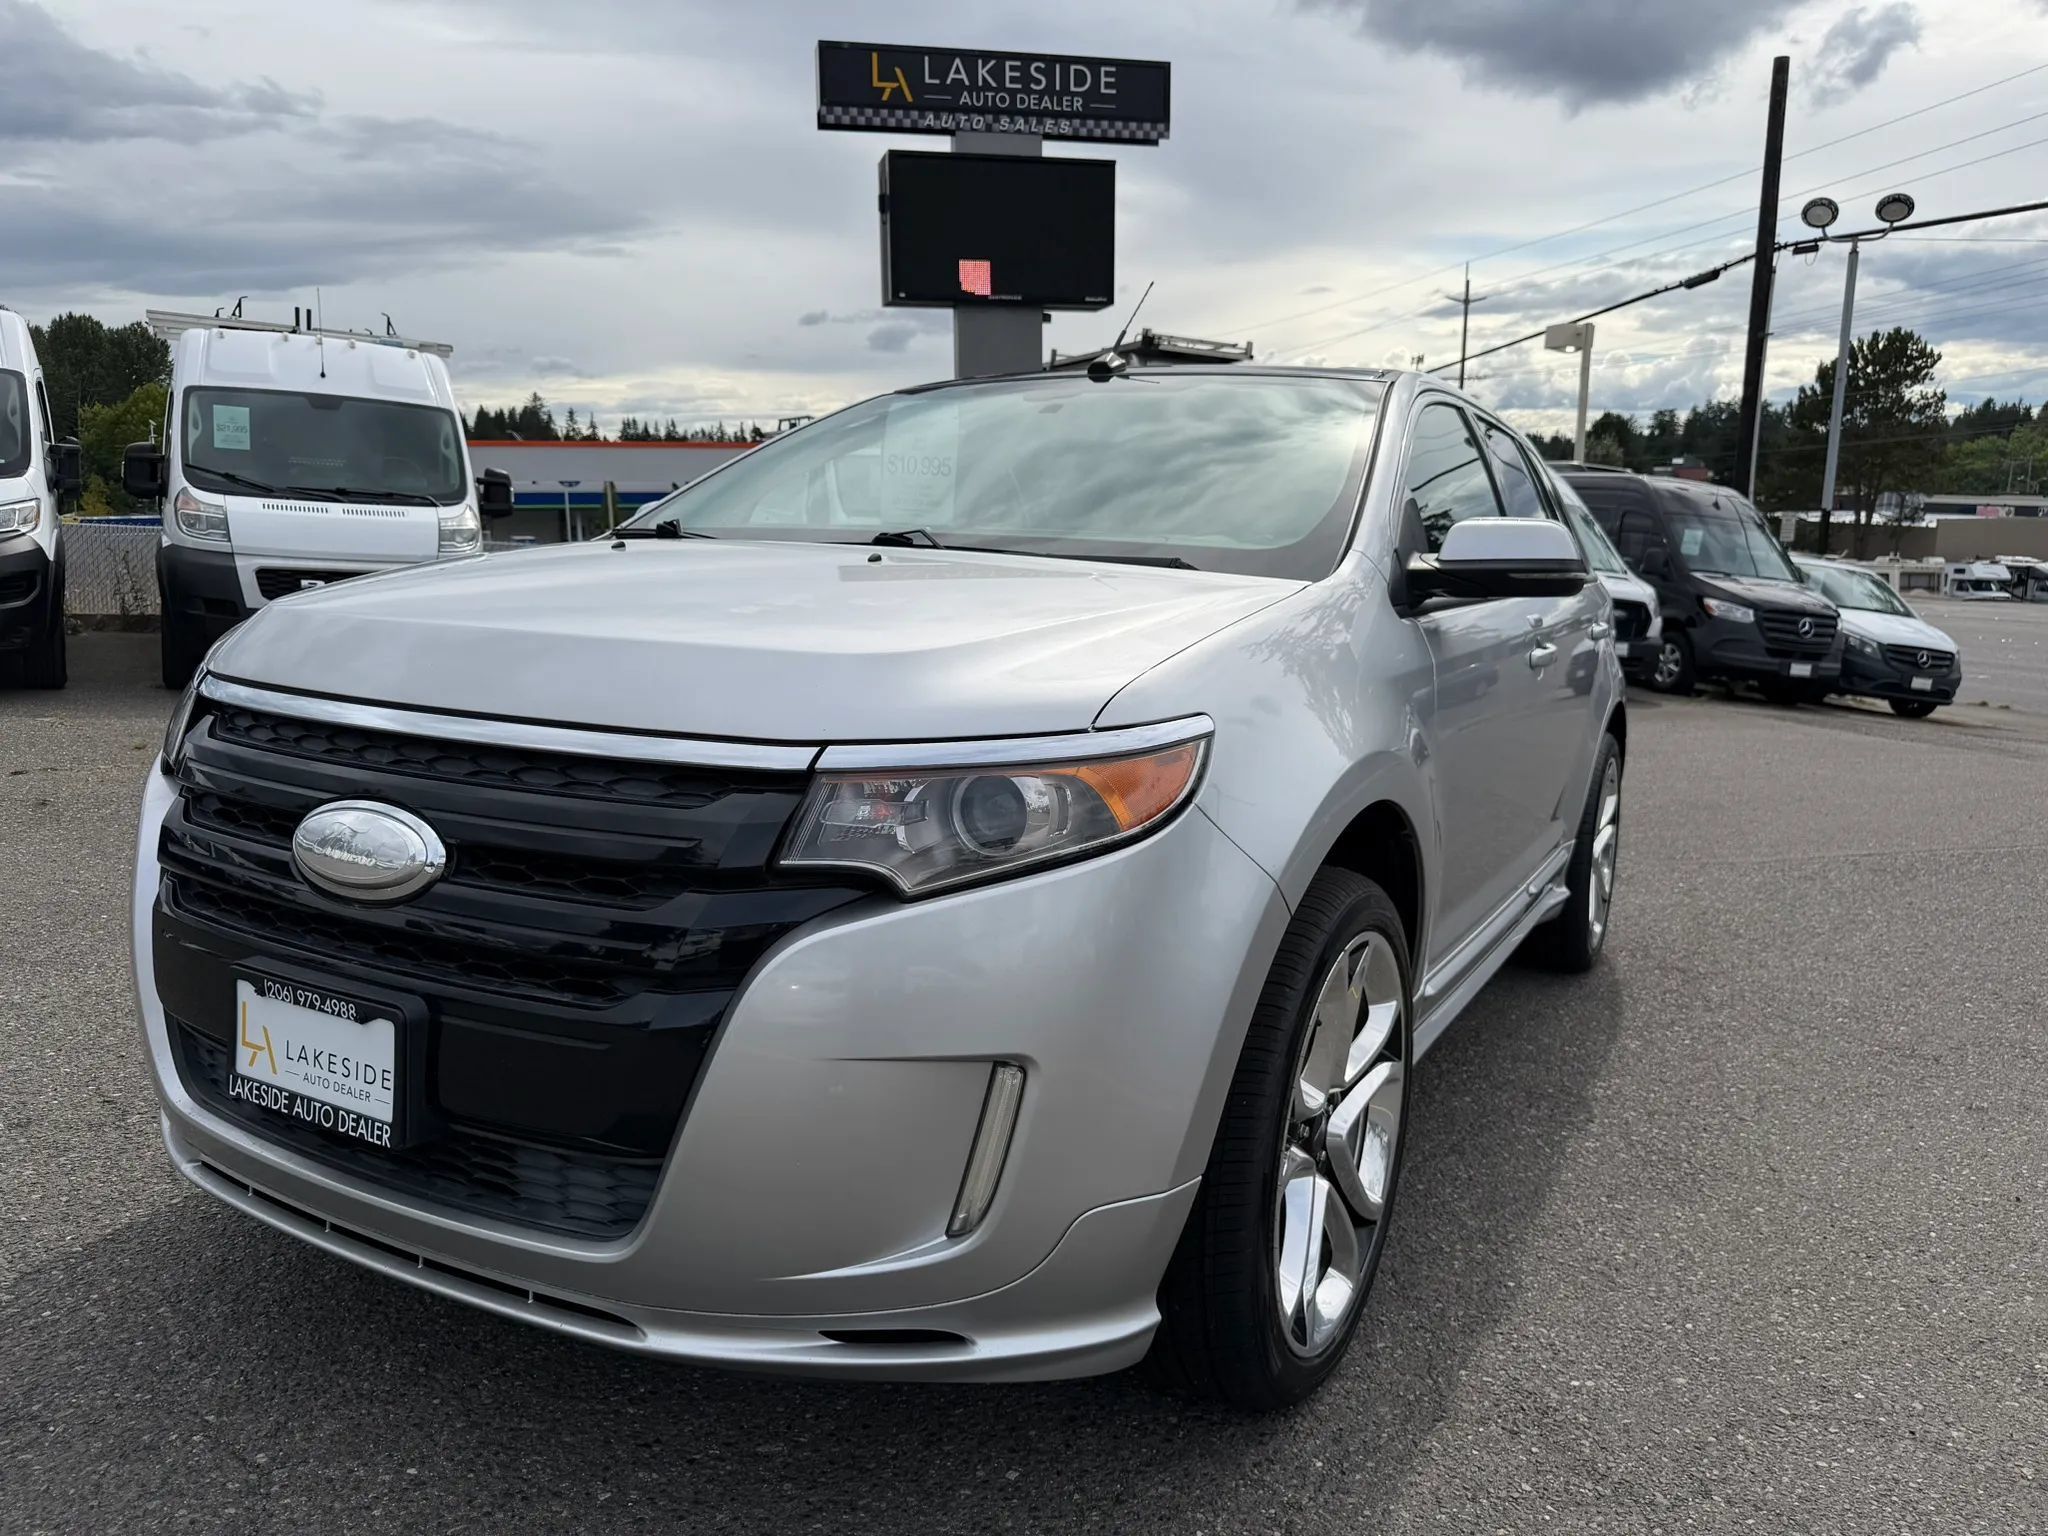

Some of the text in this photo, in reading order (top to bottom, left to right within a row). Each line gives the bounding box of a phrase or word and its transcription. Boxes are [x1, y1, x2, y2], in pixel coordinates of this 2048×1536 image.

[924, 55, 1117, 94] LAKESIDE
[959, 91, 1083, 112] AUTO DEALER
[924, 114, 1071, 134] AUTO SALES
[887, 454, 952, 477] $10,995
[264, 979, 357, 1021] (206) 979-4988
[286, 1039, 392, 1091] LAKESIDE
[302, 1072, 371, 1103] AUTO DEALER
[229, 1074, 391, 1148] LAKESIDE AUTO DEALER
